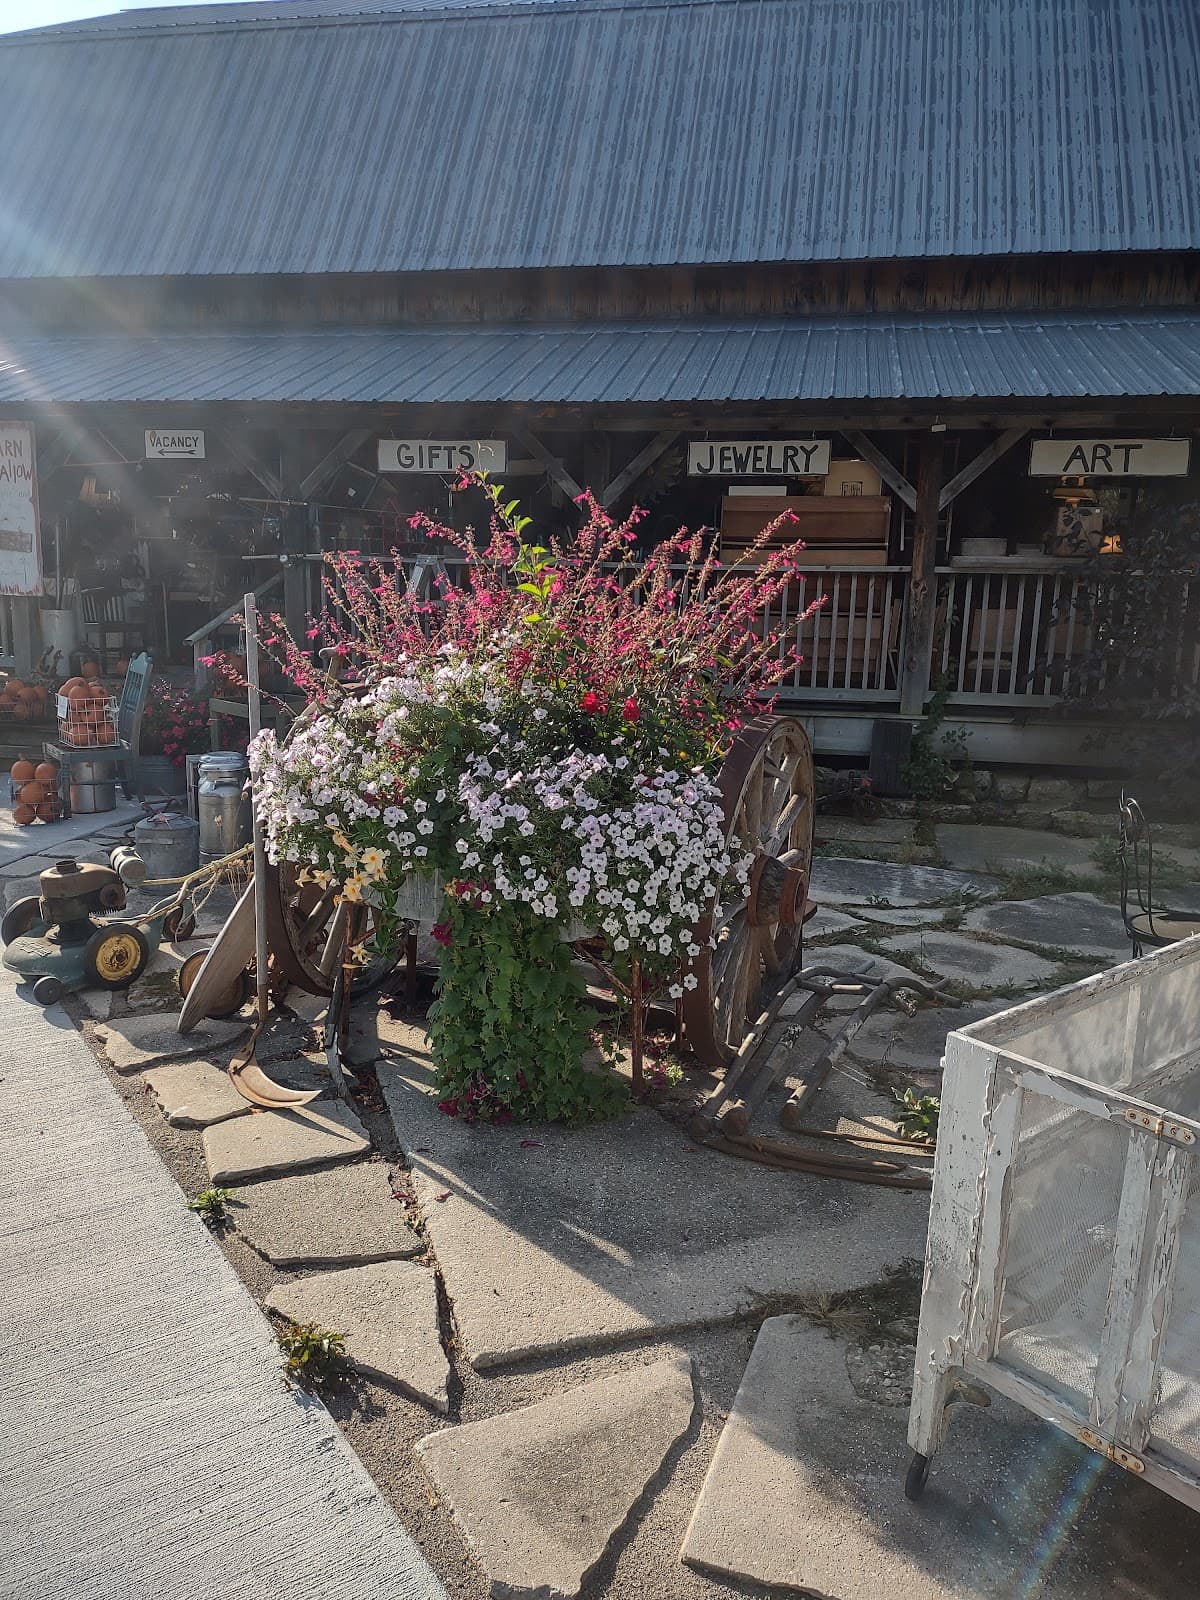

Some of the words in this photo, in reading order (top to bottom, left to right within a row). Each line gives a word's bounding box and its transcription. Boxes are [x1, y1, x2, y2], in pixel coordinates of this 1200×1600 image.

[150, 436, 199, 449] VACANCY
[396, 443, 475, 470] GIFTS
[697, 444, 819, 473] JEWELRY
[1062, 444, 1143, 473] ART
